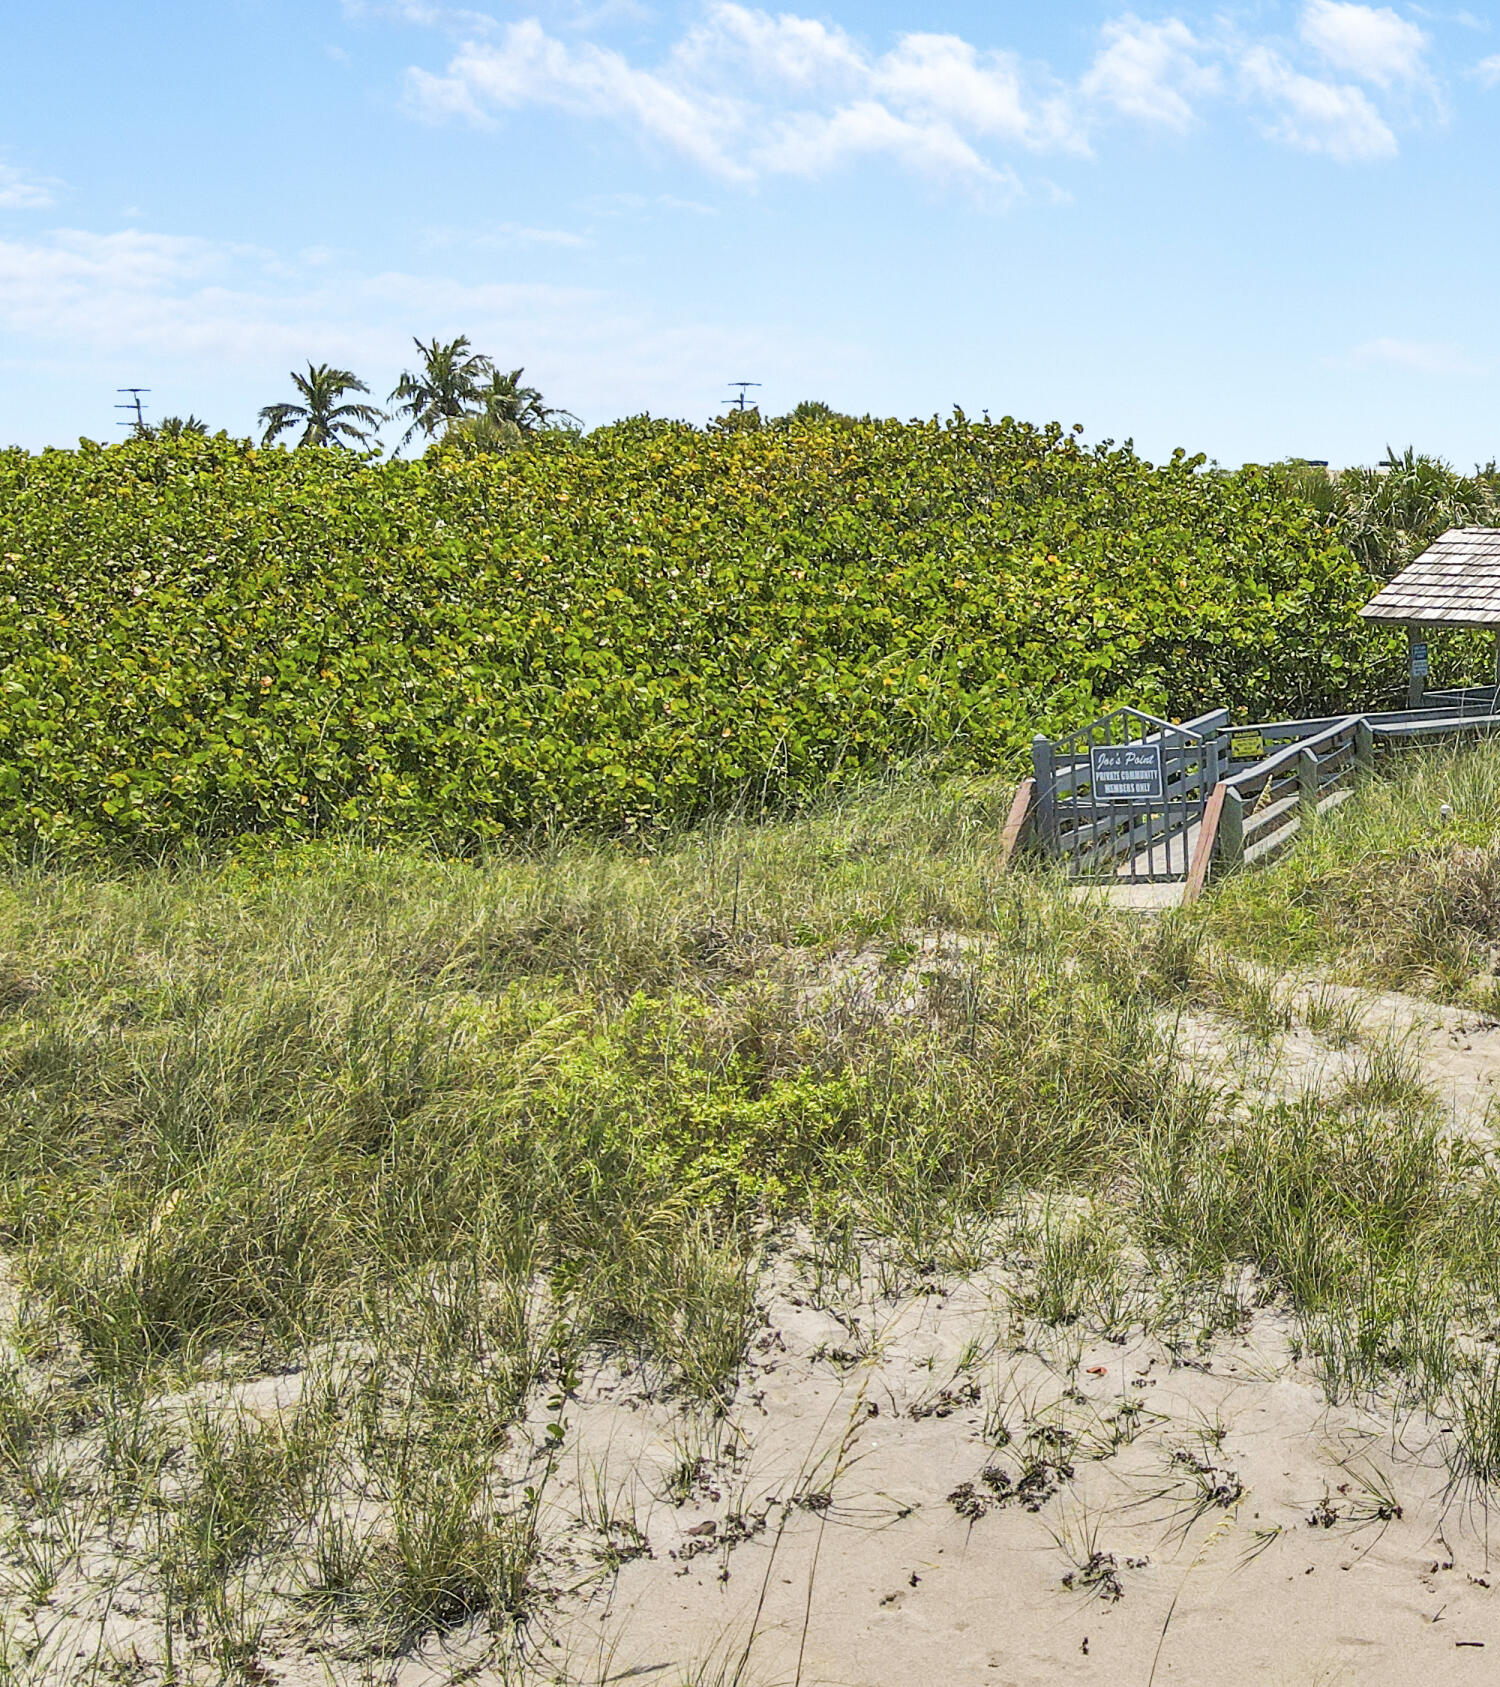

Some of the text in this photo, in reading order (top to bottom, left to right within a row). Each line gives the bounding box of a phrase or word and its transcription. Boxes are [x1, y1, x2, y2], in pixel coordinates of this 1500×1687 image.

[1098, 752, 1154, 769] Joe's Point
[1096, 770, 1157, 781] PRIVATE COMMUNITY
[1105, 783, 1150, 793] MEMBERS ONLY
